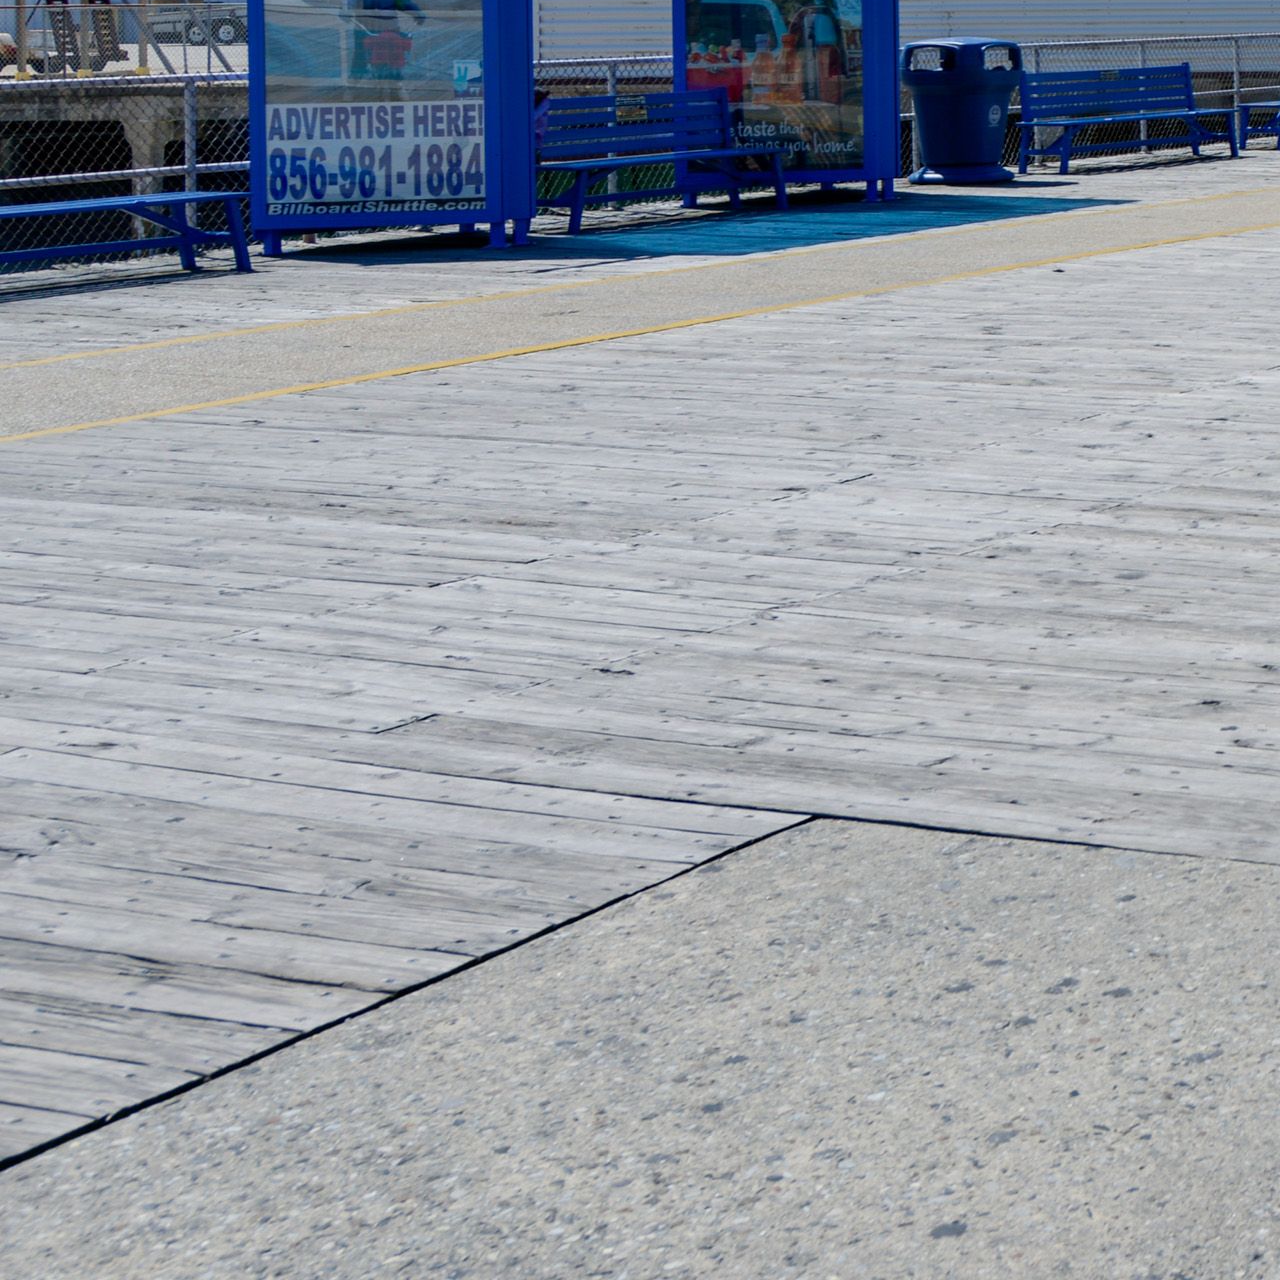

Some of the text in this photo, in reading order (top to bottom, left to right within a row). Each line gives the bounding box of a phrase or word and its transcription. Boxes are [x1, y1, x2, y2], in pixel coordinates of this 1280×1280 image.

[268, 103, 484, 141] ADVERTISE HERE!
[737, 121, 777, 138] taste
[784, 139, 811, 159] you
[269, 142, 484, 201] 856-981-1884
